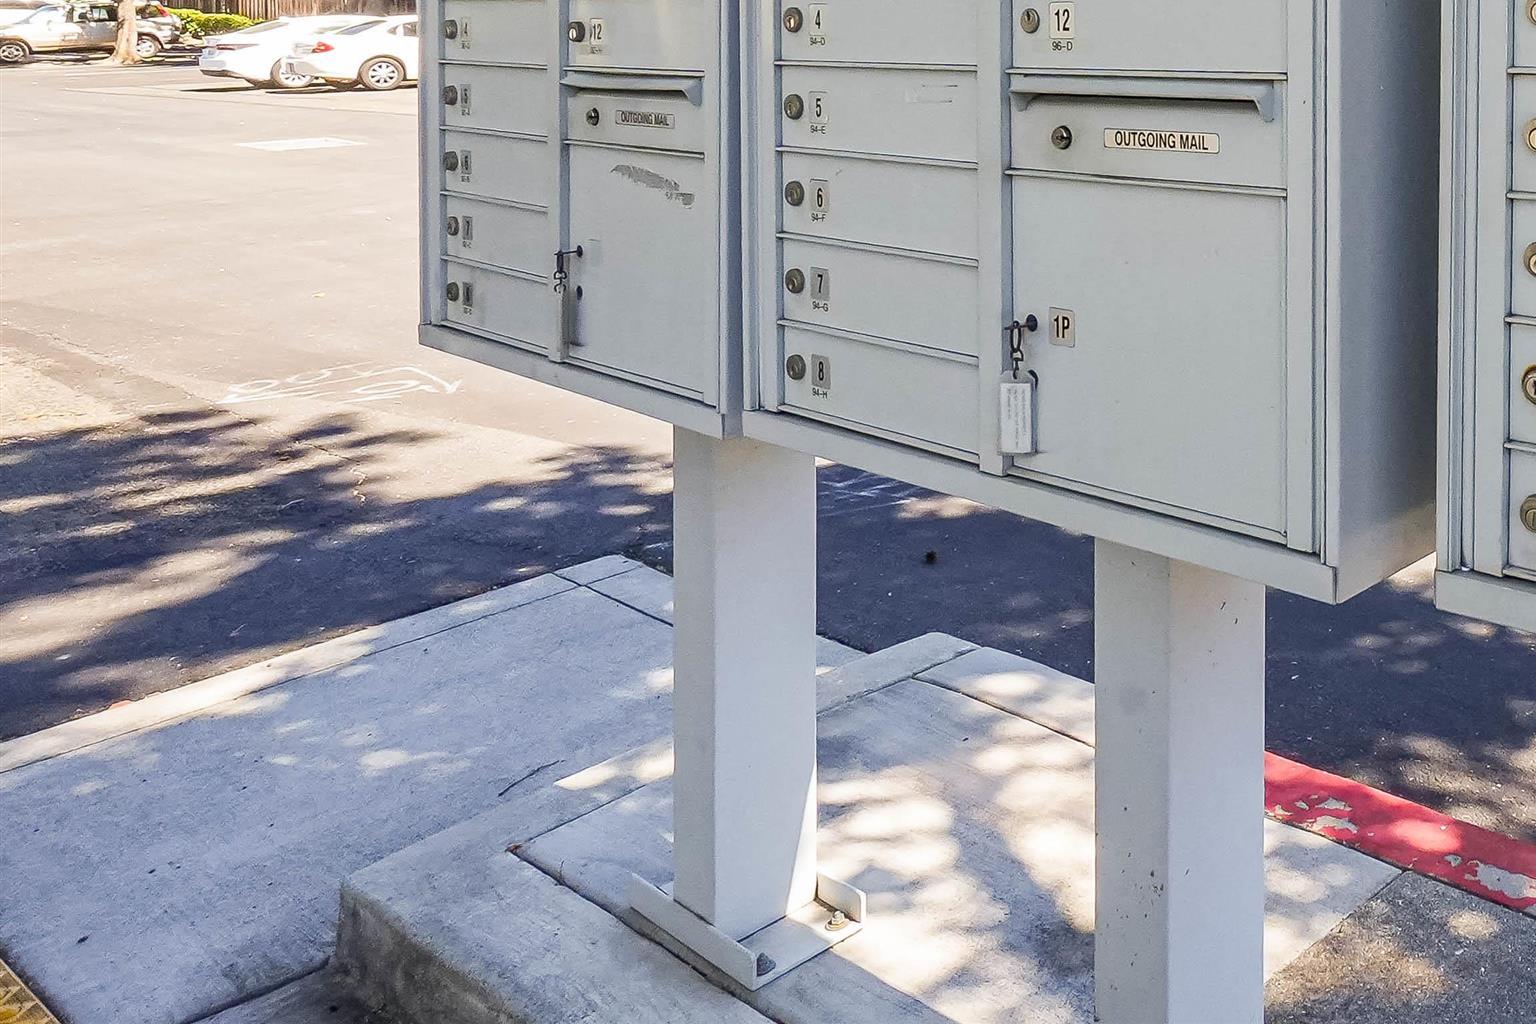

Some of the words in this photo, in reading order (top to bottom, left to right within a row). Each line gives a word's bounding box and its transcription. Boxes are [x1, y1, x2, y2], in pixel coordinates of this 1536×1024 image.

[815, 10, 822, 30] 4
[1054, 8, 1070, 32] 12
[593, 23, 602, 41] 12
[1052, 41, 1073, 51] 96-D
[815, 97, 822, 118] 5
[620, 111, 653, 125] OUTGOING
[654, 113, 670, 126] MAIL
[1114, 131, 1176, 149] OUTGOING
[1180, 134, 1209, 150] MAIL
[816, 187, 823, 207] 6
[817, 274, 823, 293] 7
[1053, 314, 1070, 339] 1P
[817, 361, 825, 381] 8
